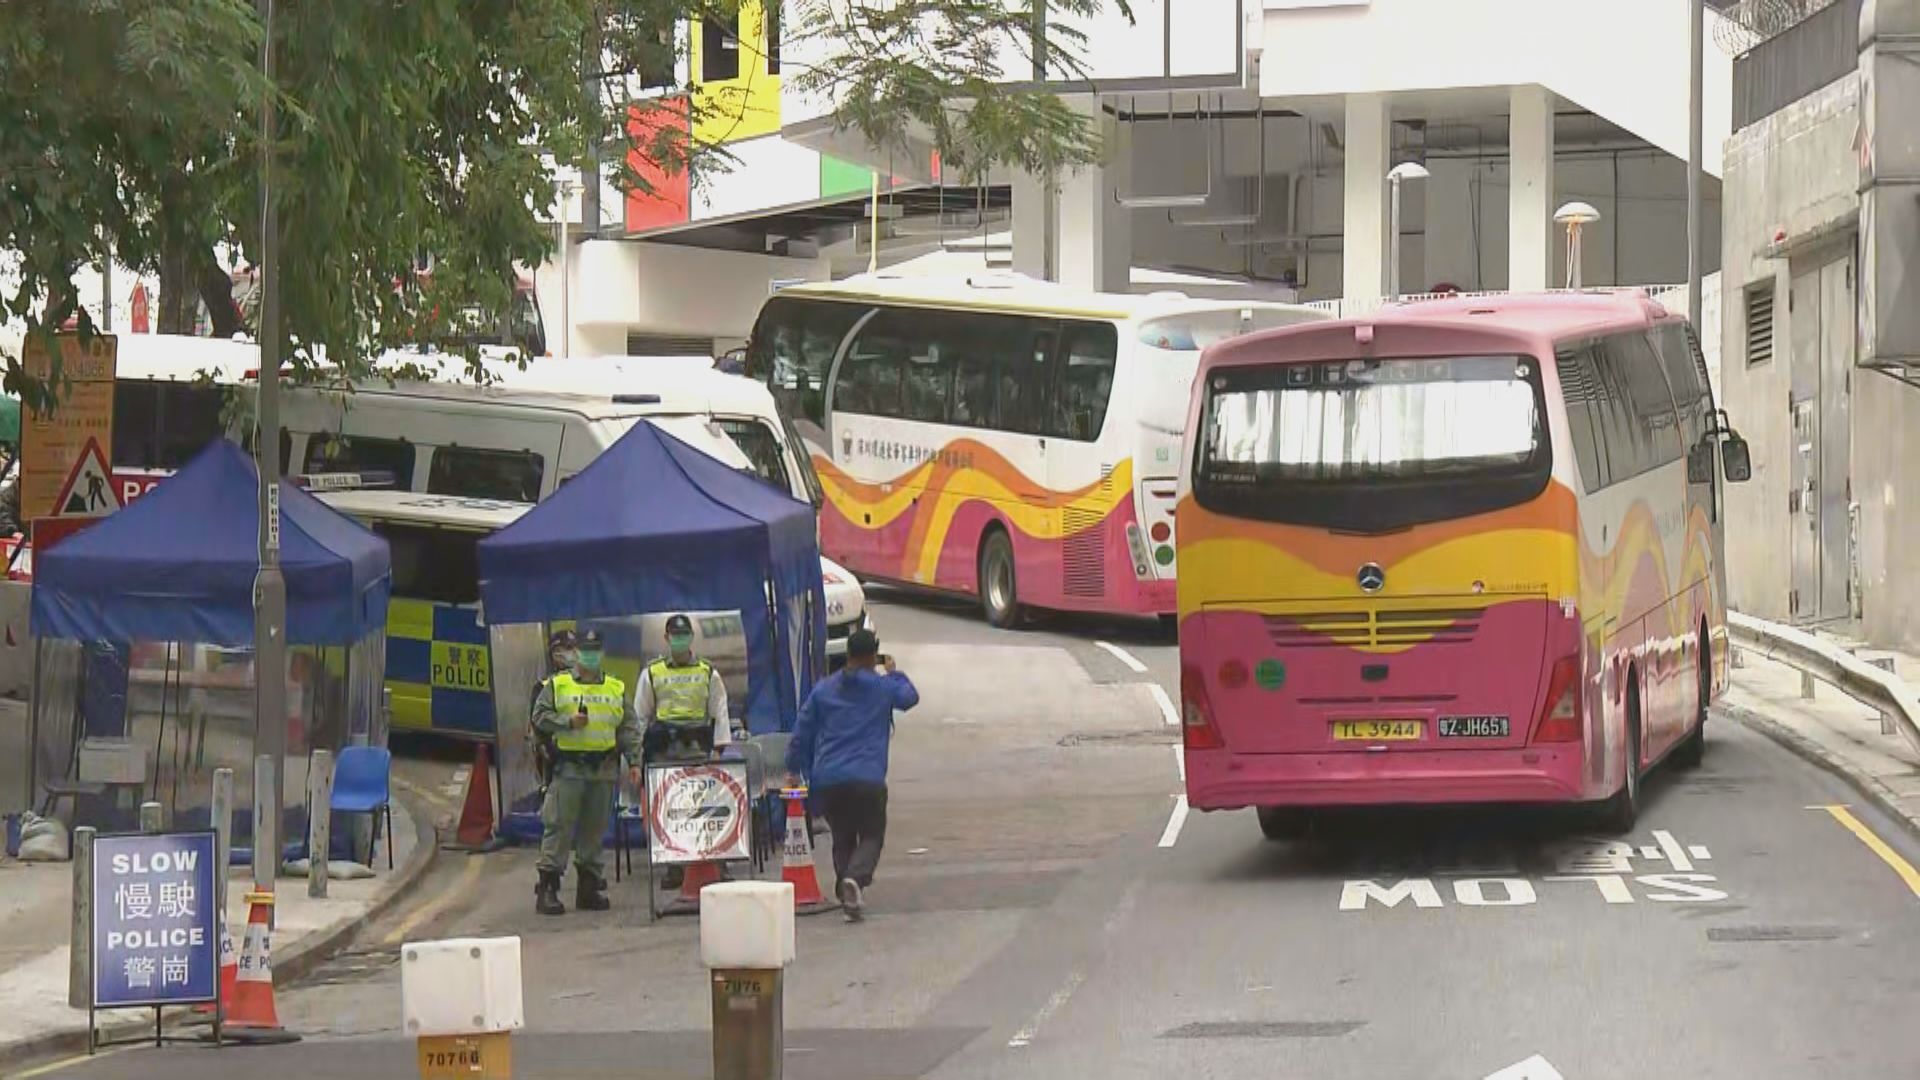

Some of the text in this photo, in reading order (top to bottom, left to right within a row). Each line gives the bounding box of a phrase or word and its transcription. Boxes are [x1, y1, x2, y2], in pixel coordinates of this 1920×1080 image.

[123, 481, 158, 505] P
[1342, 721, 1416, 738] TL 3944
[111, 850, 198, 874] SLOW
[114, 879, 196, 921] 慢駛
[1339, 873, 1728, 909] SLOW
[107, 927, 205, 950] POLICE
[123, 954, 189, 989] 警崗
